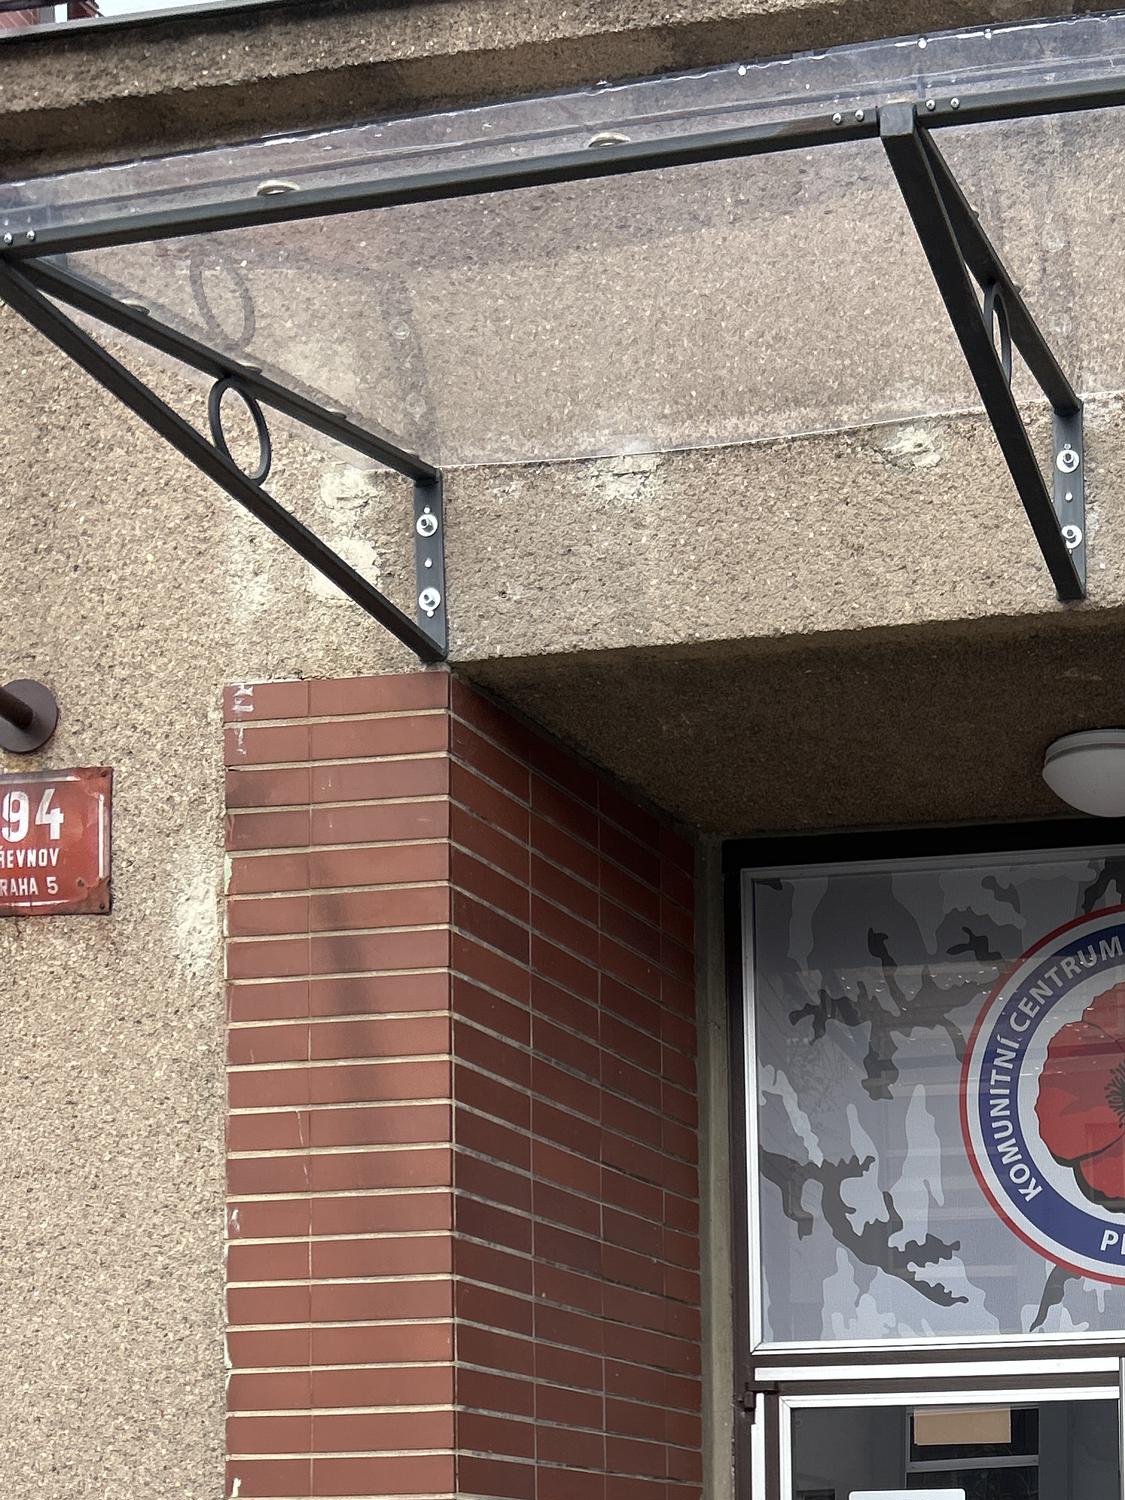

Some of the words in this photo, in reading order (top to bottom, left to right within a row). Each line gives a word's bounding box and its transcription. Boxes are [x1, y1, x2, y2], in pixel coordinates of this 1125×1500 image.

[1, 787, 65, 843] 94
[46, 876, 59, 895] 5
[1009, 934, 1124, 1035] CENTRUM
[988, 1036, 1044, 1202] KOMUNITNÍ
